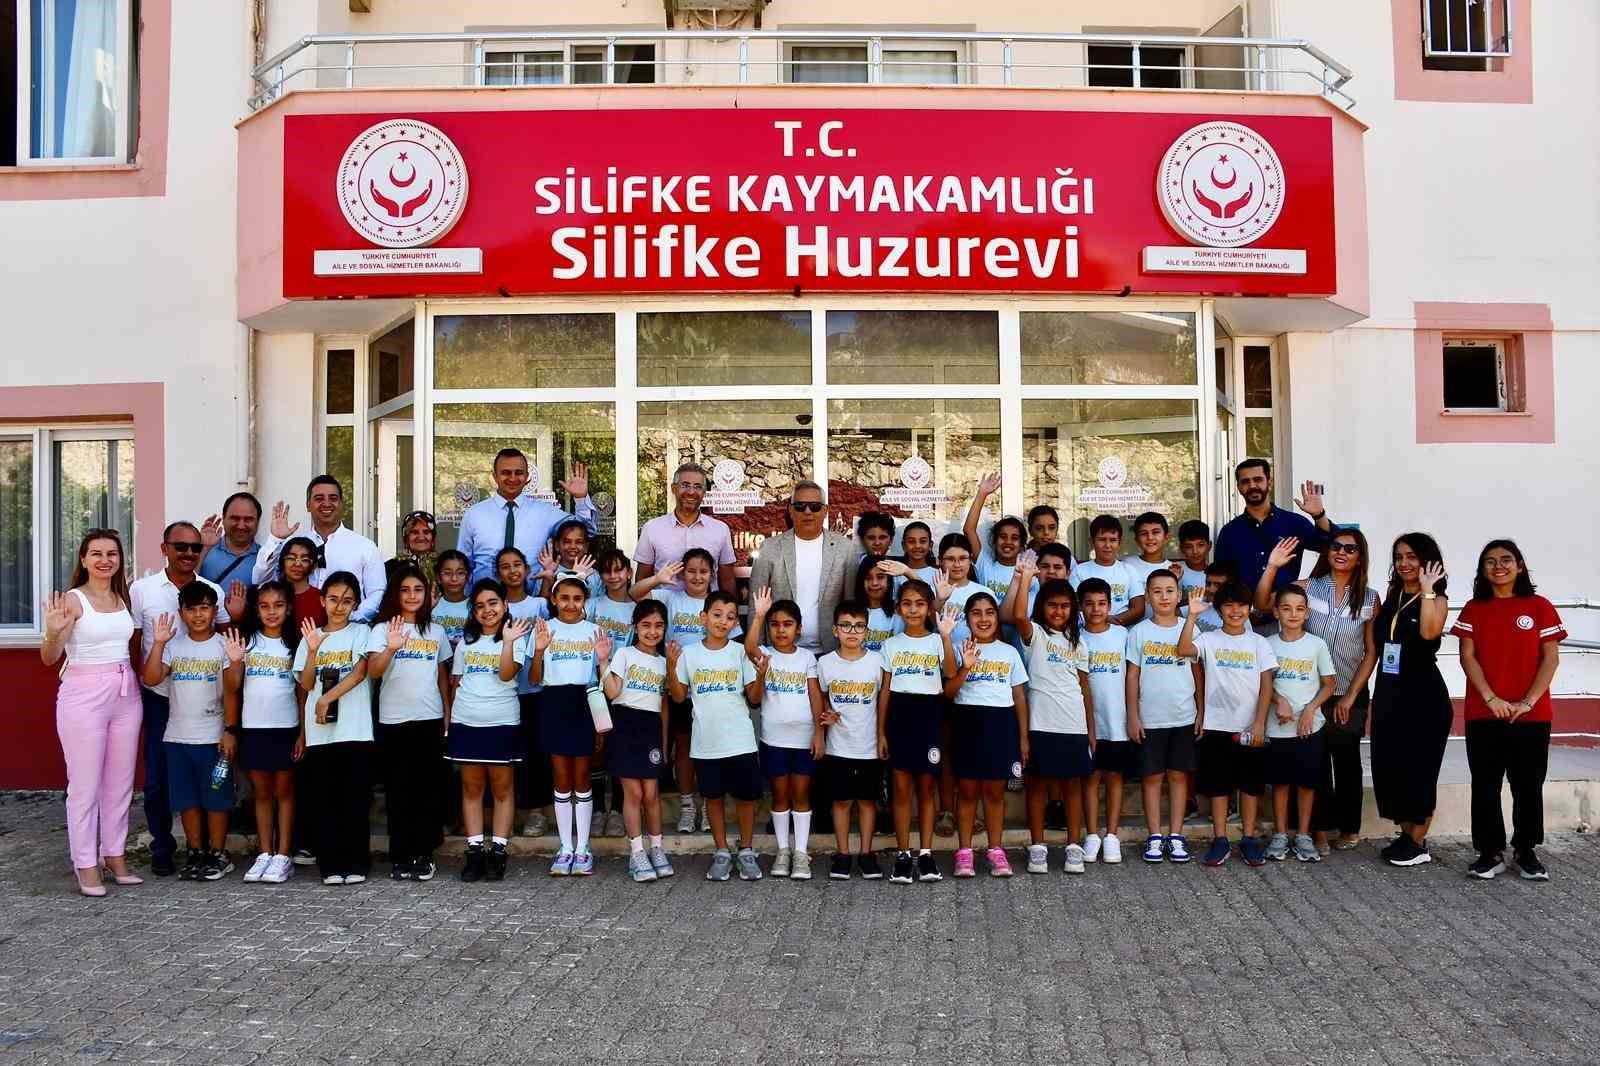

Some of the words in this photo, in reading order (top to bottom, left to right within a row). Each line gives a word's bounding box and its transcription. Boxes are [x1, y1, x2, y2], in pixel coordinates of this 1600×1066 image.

[775, 120, 857, 158] T.C.
[534, 166, 711, 214] SİLİFKE
[728, 167, 1094, 214] KAYMAKAMLIĞI
[361, 252, 391, 260] TÜRKİYE
[391, 252, 437, 260] CUMHURİYETİ
[551, 224, 761, 279] Silifke
[785, 225, 1079, 278] Huzurevi
[1194, 250, 1222, 258] TÜRKİYE
[1223, 251, 1267, 259] CUMHURİYETİ
[332, 262, 347, 270] AİLE
[386, 261, 424, 269] HİZMETLER
[425, 261, 462, 269] BAKANLIĞI
[1165, 258, 1180, 266] AİLE
[1218, 259, 1254, 268] HİZMETLER
